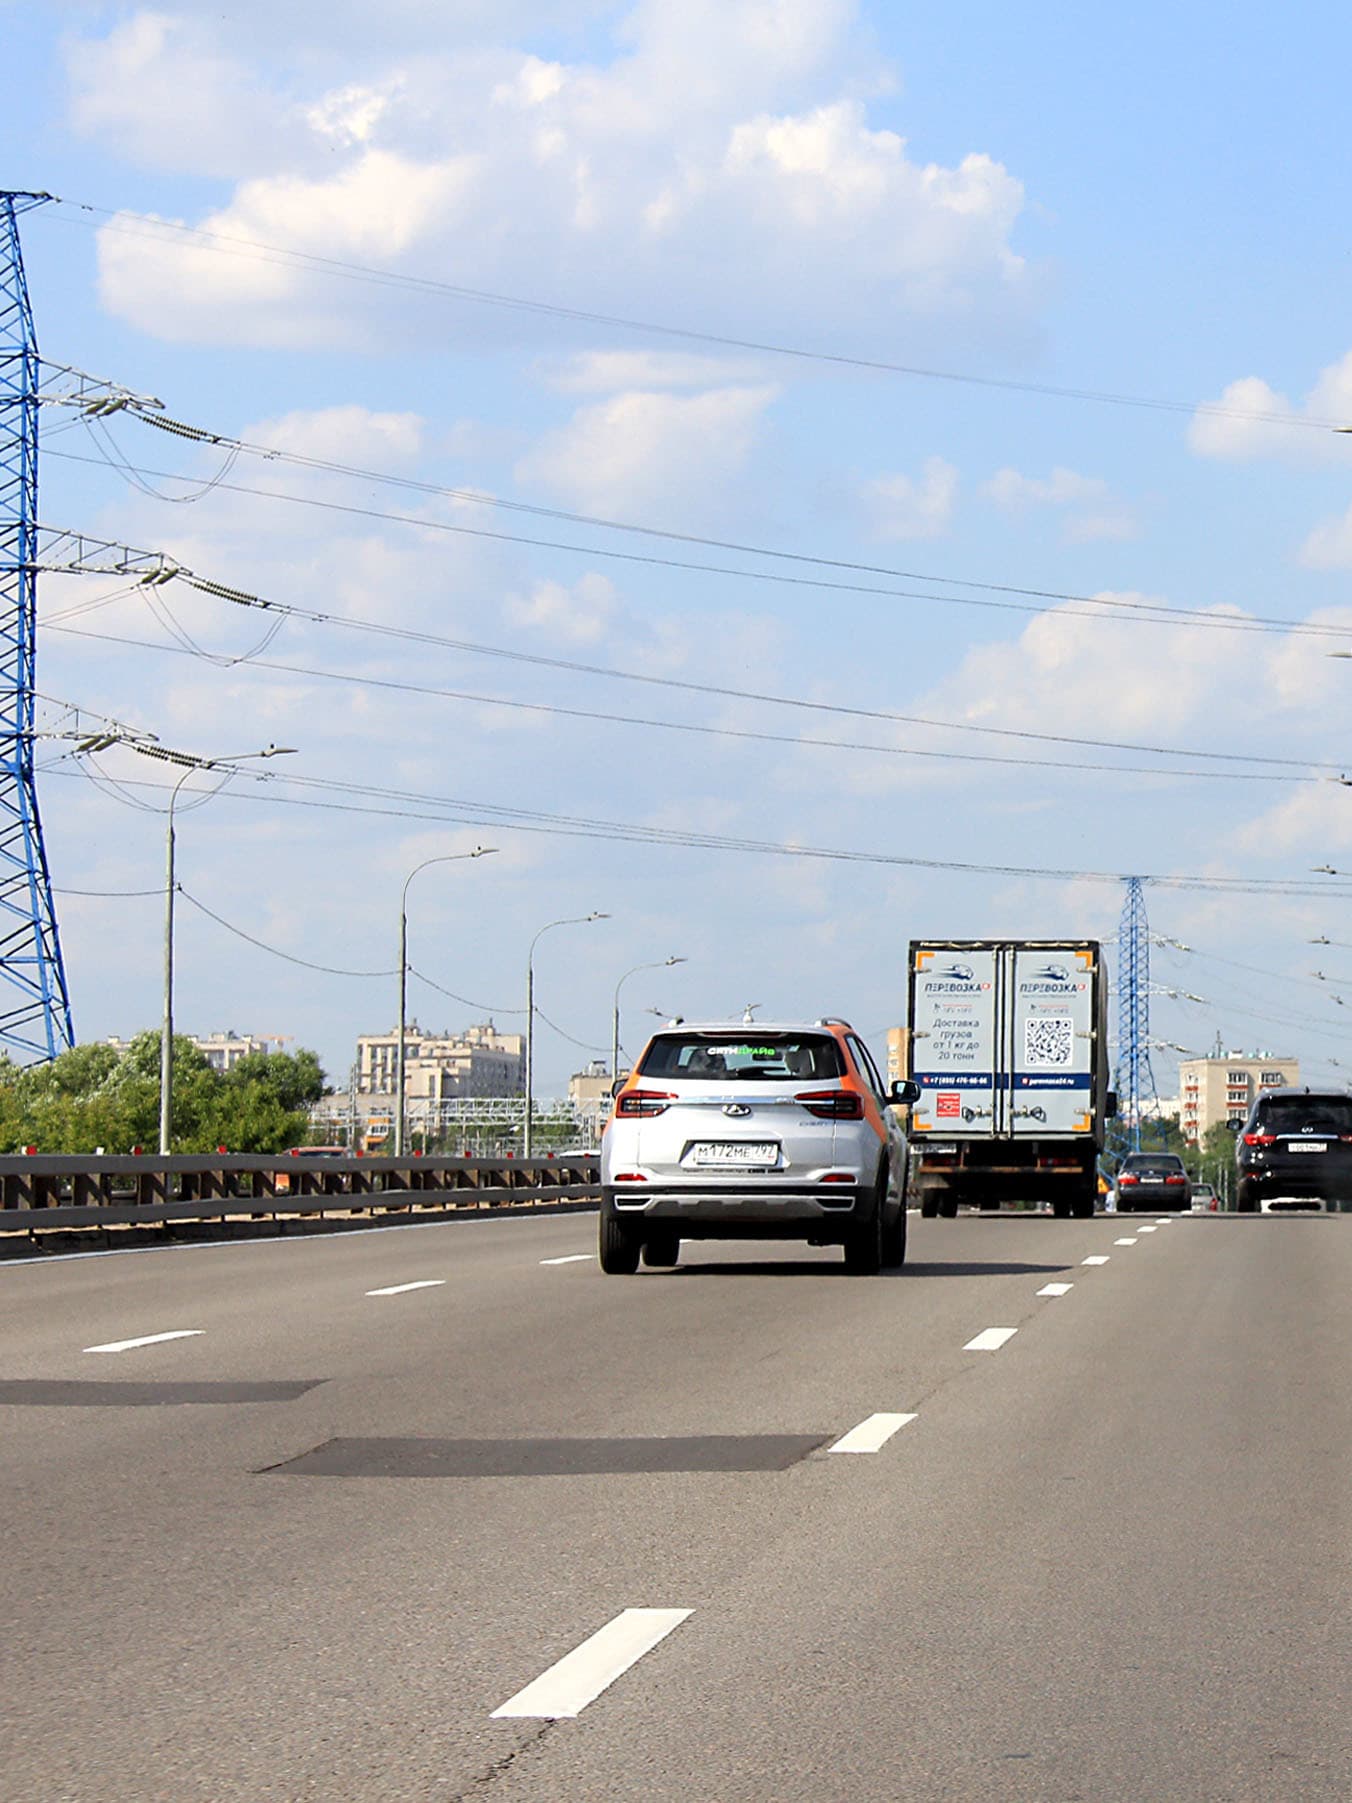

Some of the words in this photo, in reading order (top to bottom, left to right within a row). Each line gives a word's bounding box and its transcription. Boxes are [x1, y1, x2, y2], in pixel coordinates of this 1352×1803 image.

[932, 1018, 980, 1028] Доставка
[940, 1031, 973, 1040] грузов
[966, 1042, 980, 1050] до
